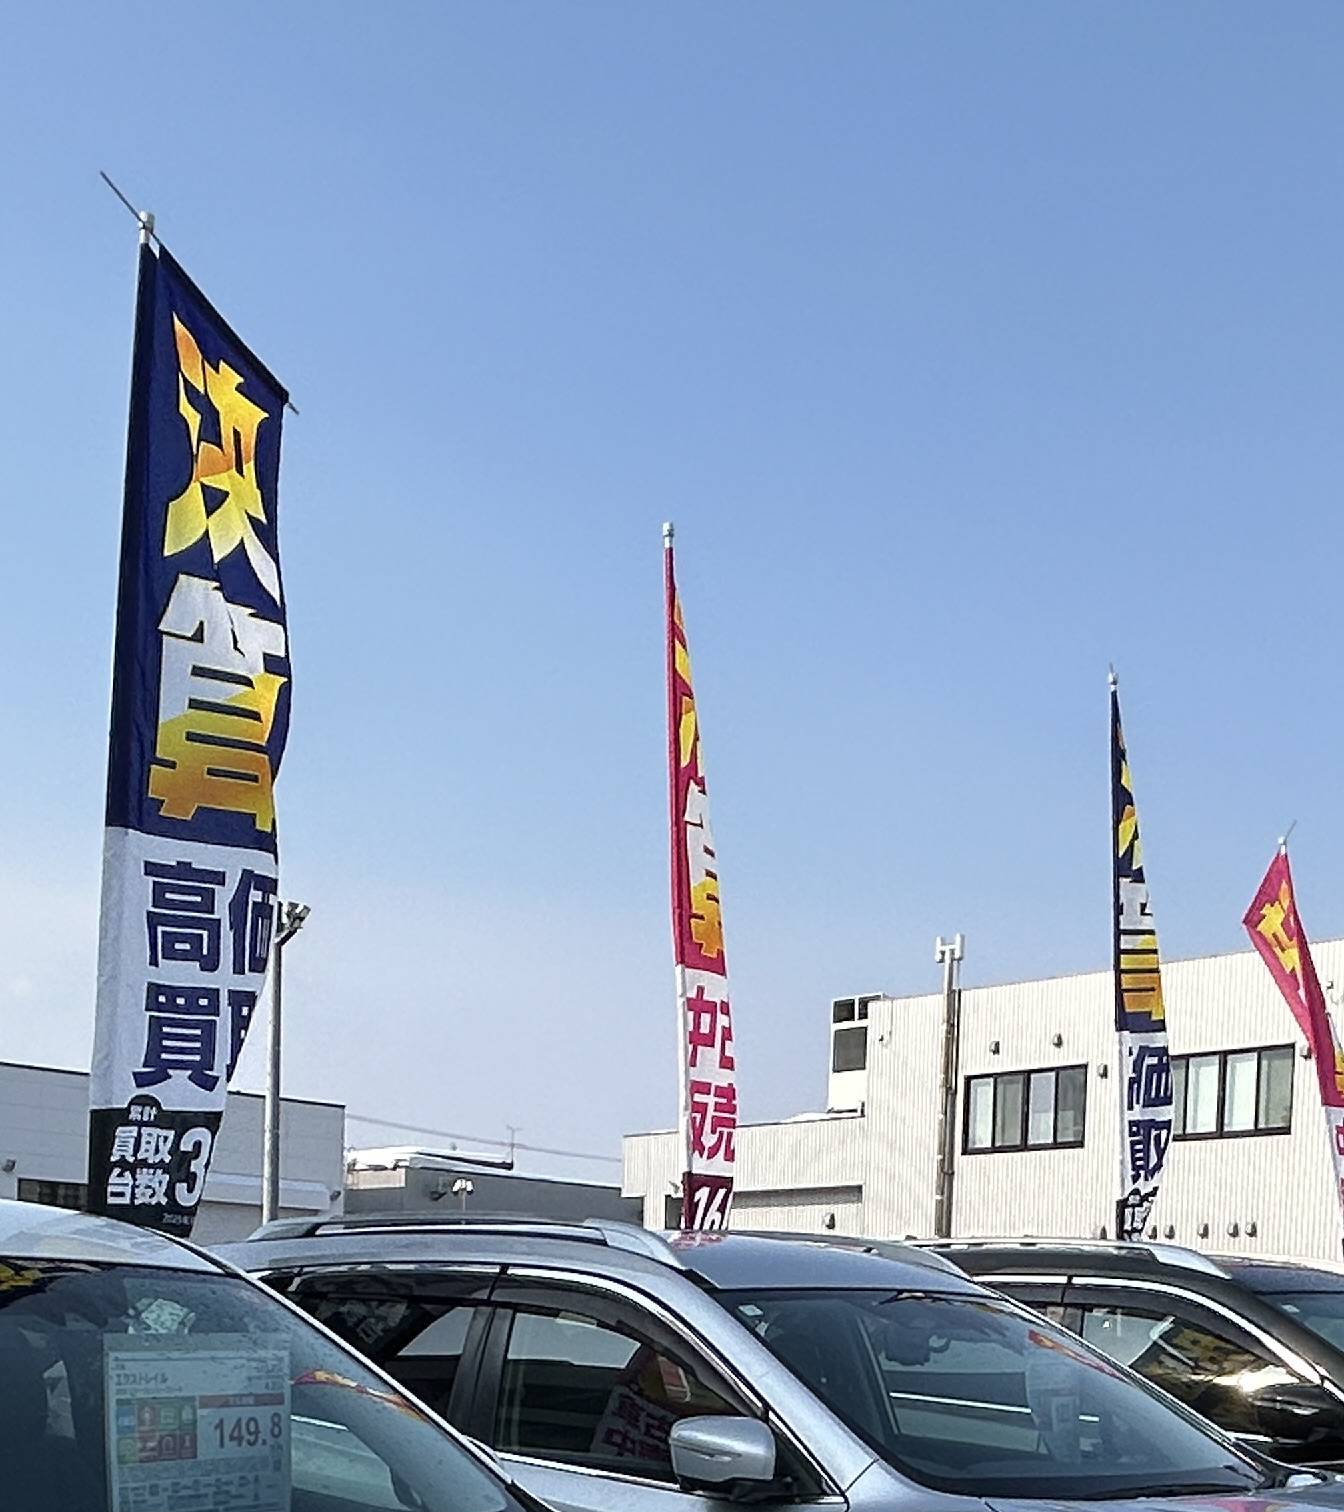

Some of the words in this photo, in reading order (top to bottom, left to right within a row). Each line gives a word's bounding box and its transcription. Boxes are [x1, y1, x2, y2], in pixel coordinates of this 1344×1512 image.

[149, 312, 288, 832] 決算
[110, 1126, 175, 1163] 買取
[107, 1168, 170, 1206] 台数
[692, 1186, 729, 1230] 16
[214, 1411, 283, 1449] 149.8
